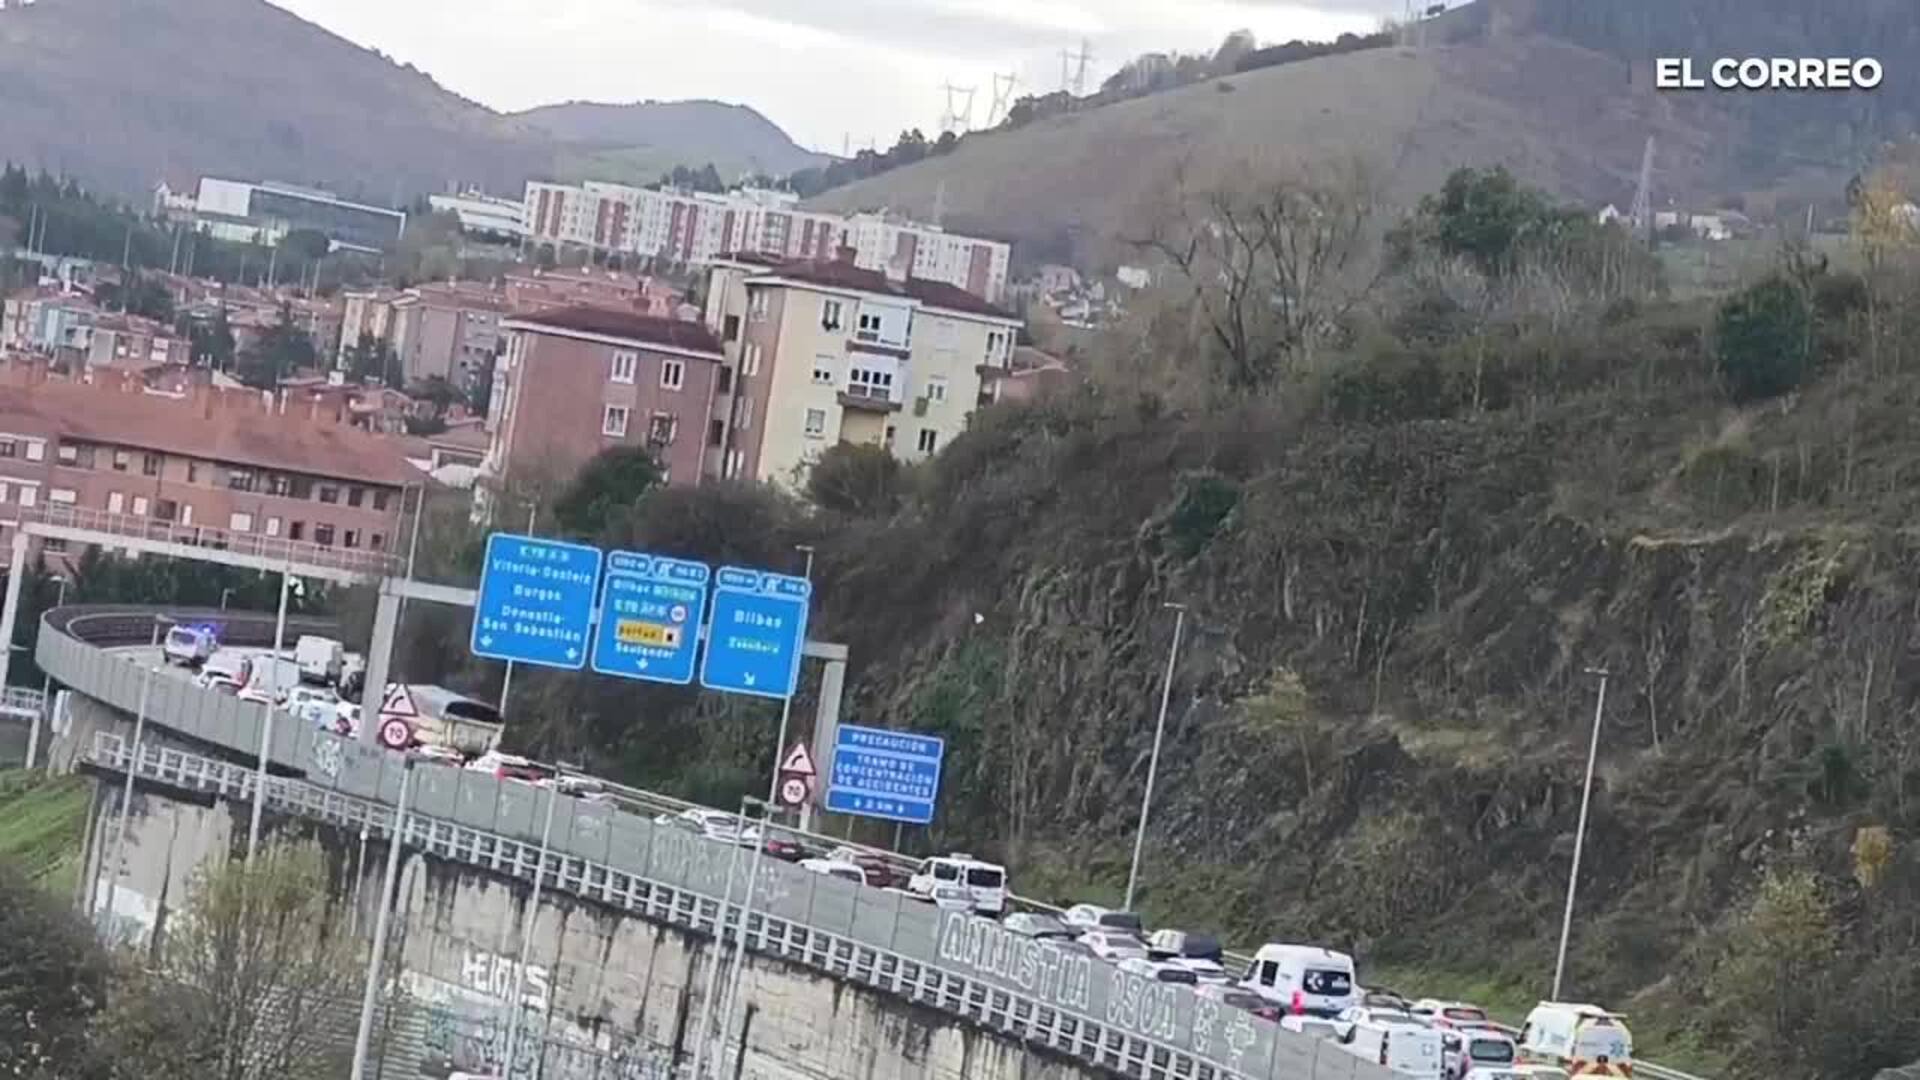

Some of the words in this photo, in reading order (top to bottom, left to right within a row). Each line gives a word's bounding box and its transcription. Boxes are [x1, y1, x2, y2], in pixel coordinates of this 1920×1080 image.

[513, 584, 562, 600] Burgos
[482, 617, 508, 631] San
[733, 609, 782, 628] Bilbao
[857, 754, 897, 769] TRAMO
[900, 760, 914, 772] DE
[838, 774, 853, 786] DE
[857, 778, 929, 797] ACCIDENTES
